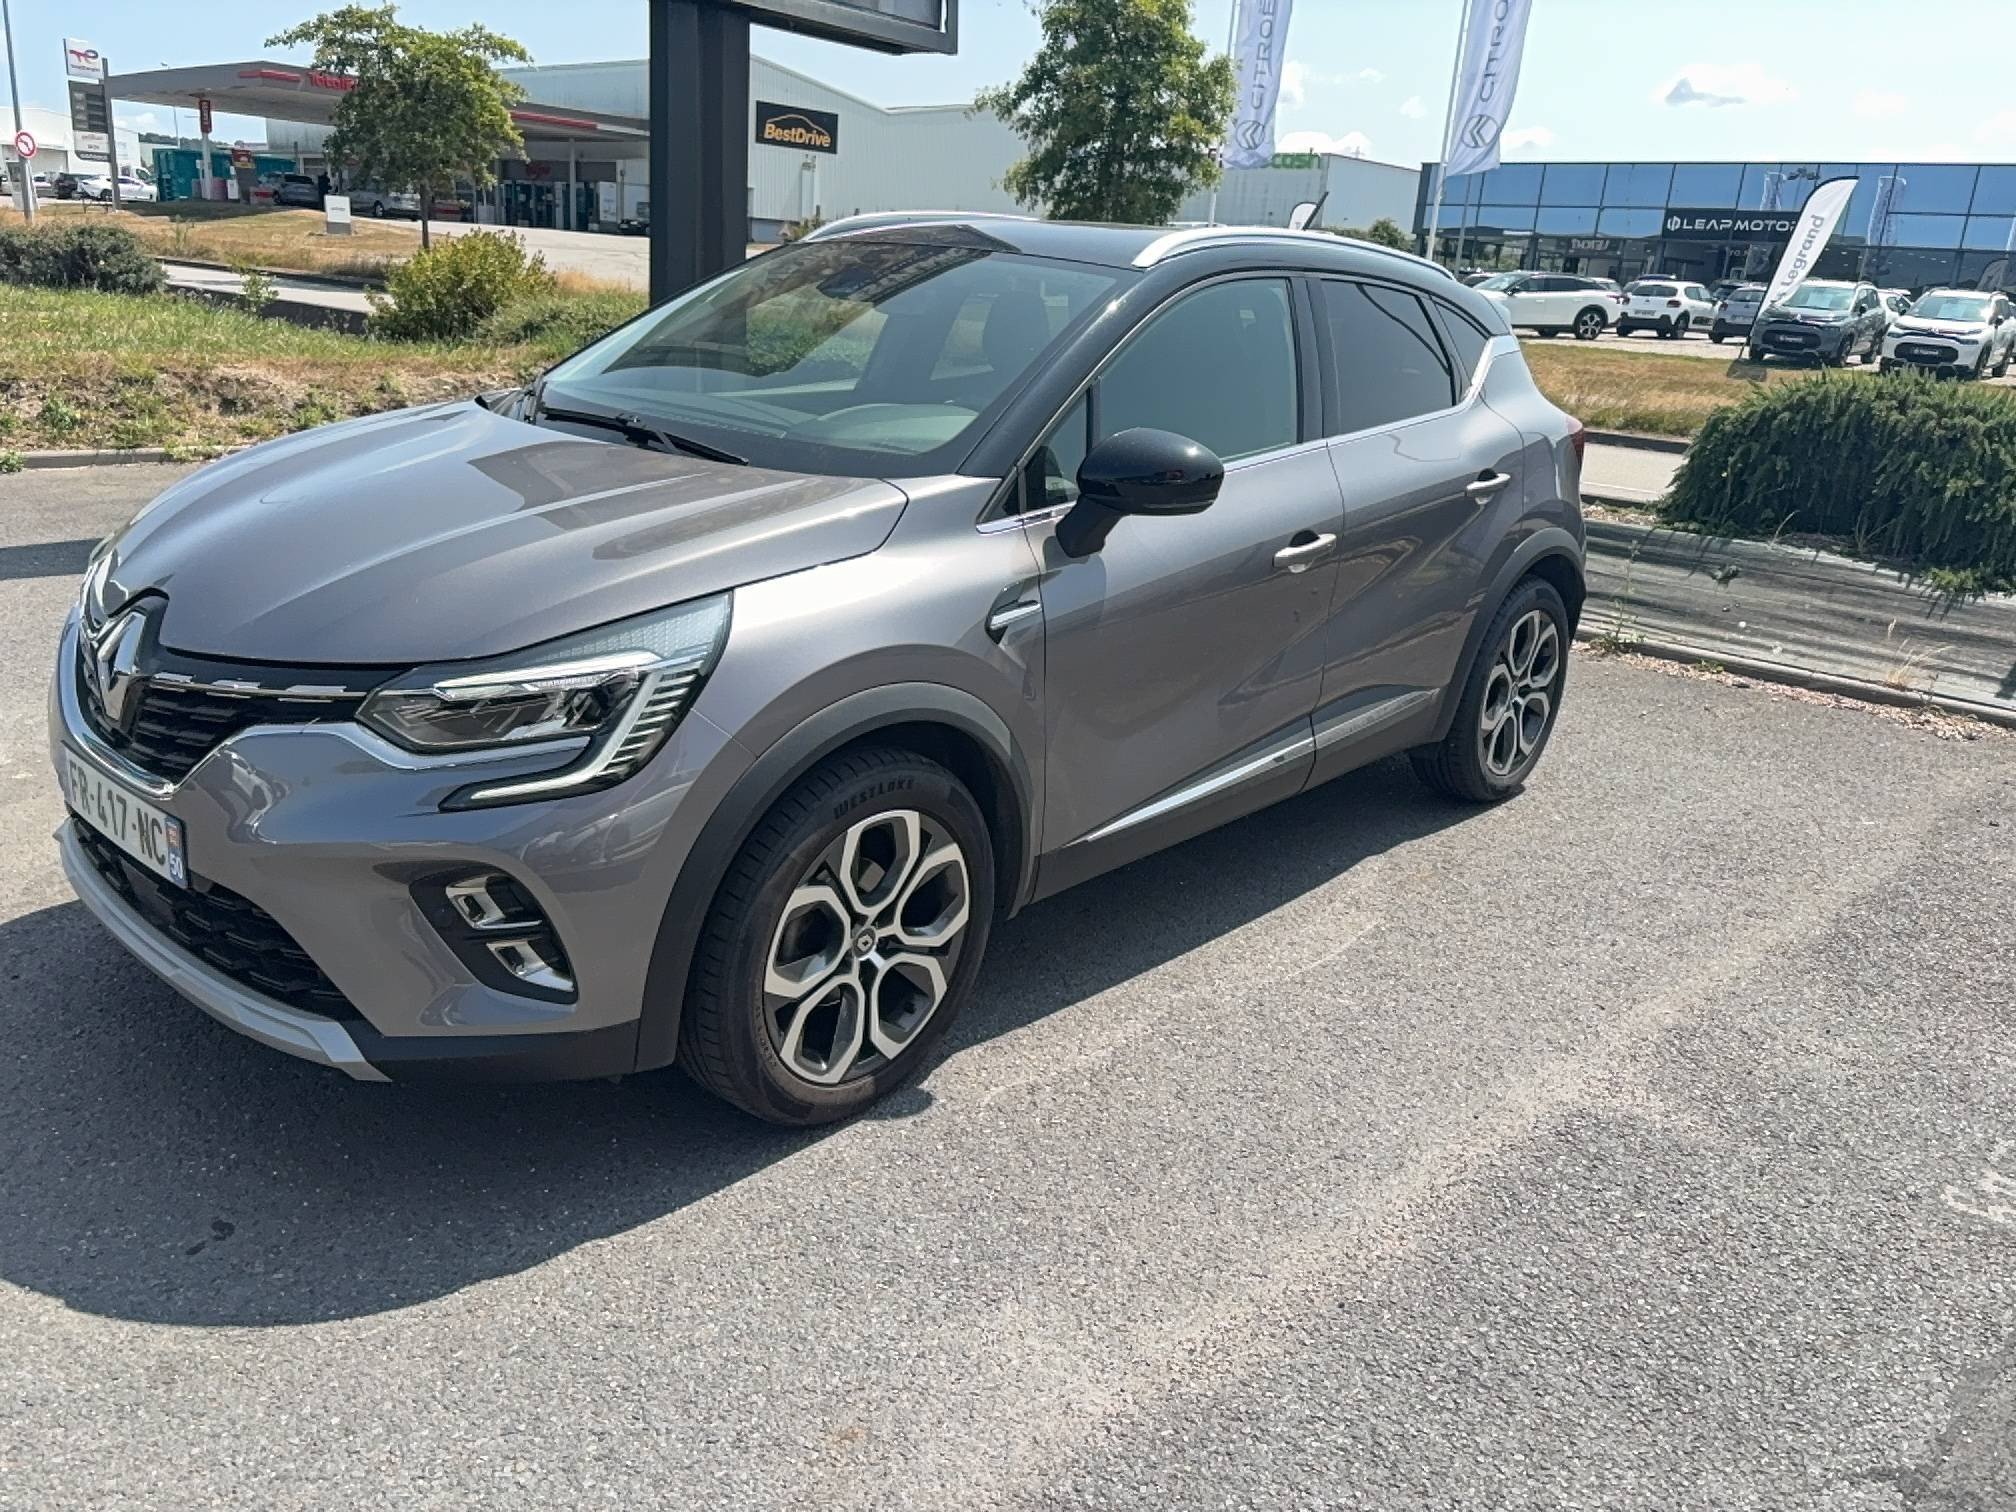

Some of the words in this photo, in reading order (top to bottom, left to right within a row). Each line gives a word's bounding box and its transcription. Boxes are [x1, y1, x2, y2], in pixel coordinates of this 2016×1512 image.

[763, 123, 832, 148] BestDrive
[1780, 214, 1825, 287] Legrand
[69, 760, 166, 866] FR-417-NC
[833, 775, 915, 819] WESTLAKE
[169, 852, 183, 880] 50
